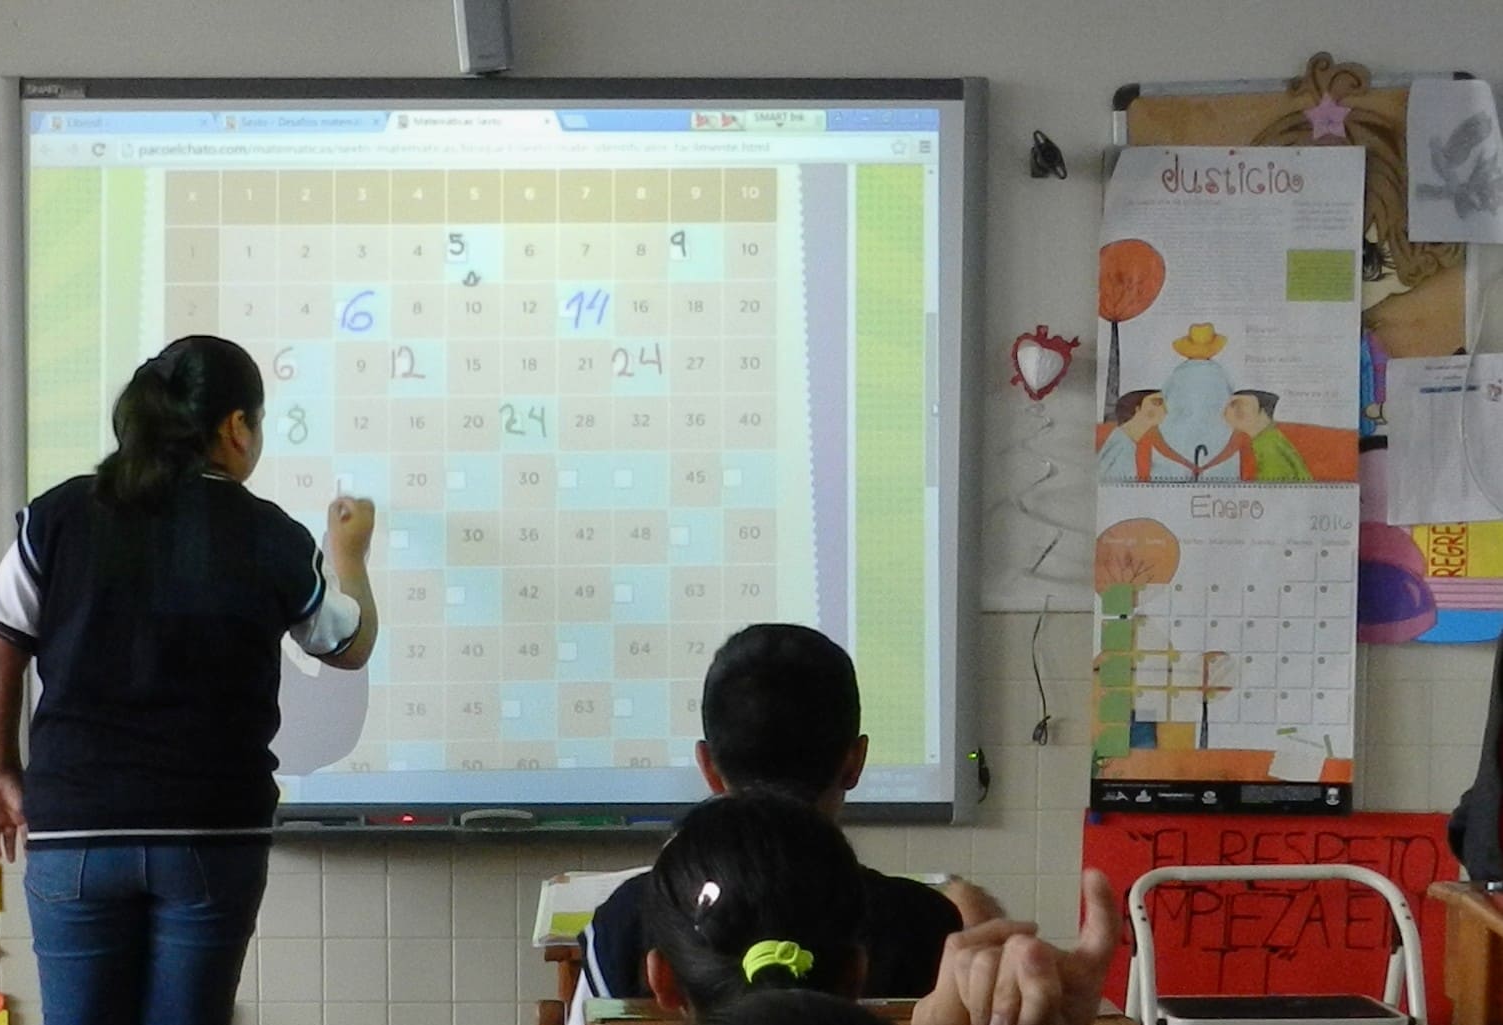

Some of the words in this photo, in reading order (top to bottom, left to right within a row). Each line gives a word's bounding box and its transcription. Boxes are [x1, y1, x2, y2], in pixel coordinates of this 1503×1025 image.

[754, 112, 788, 123] SMART
[301, 188, 311, 202] 2
[357, 187, 367, 201] 3
[412, 188, 423, 200] 4
[469, 186, 480, 201] 5
[524, 187, 535, 201] 6
[582, 186, 591, 199] 7
[636, 186, 647, 200] 8
[690, 186, 702, 200] 9
[741, 186, 760, 199] 10
[301, 244, 311, 259] 2
[358, 244, 367, 259] 3
[412, 244, 423, 257] 4
[448, 232, 465, 256] 5
[524, 243, 535, 257] 6
[582, 243, 591, 257] 7
[635, 243, 647, 257] 8
[669, 230, 687, 257] 9
[741, 242, 759, 257] 10
[244, 303, 254, 317] 2
[300, 303, 310, 315] 4
[340, 290, 375, 332] 6
[412, 301, 423, 315] 8
[465, 300, 483, 315] 10
[522, 300, 538, 315] 12
[566, 288, 610, 329] 14
[633, 299, 649, 314] 16
[687, 300, 704, 313] 18
[739, 299, 761, 313] 20
[272, 346, 295, 381] 6
[356, 359, 367, 373] 9
[390, 345, 427, 380] 12
[465, 357, 482, 372] 15
[521, 357, 538, 372] 18
[577, 357, 594, 372] 21
[611, 342, 663, 378] 24
[686, 356, 705, 371] 27
[740, 356, 761, 370] 30
[286, 404, 309, 446] 8
[353, 416, 370, 431] 12
[409, 415, 426, 430] 16
[462, 415, 485, 429] 20
[498, 403, 547, 438] 24
[575, 414, 595, 428] 28
[631, 413, 651, 428] 32
[686, 413, 706, 427] 36
[738, 412, 762, 427] 40
[295, 473, 314, 489] 10
[406, 472, 428, 487] 20
[519, 471, 540, 486] 30
[685, 469, 706, 485] 45
[1190, 493, 1265, 521] Enero
[1309, 514, 1353, 533] 2016
[463, 528, 485, 543] 30
[519, 527, 540, 542] 36
[575, 527, 595, 541] 42
[629, 526, 652, 541] 48
[738, 525, 761, 540] 60
[1431, 521, 1466, 577] REGRE
[407, 587, 427, 601] 28
[518, 585, 539, 600] 42
[574, 585, 595, 598] 49
[684, 583, 706, 598] 63
[741, 583, 761, 598] 70
[406, 644, 427, 659] 32
[461, 643, 485, 658] 40
[518, 642, 540, 657] 48
[629, 641, 651, 656] 64
[687, 641, 705, 655] 72
[406, 702, 427, 717] 36
[462, 701, 483, 716] 45
[573, 699, 595, 714] 63
[1218, 829, 1440, 893] RESPETO
